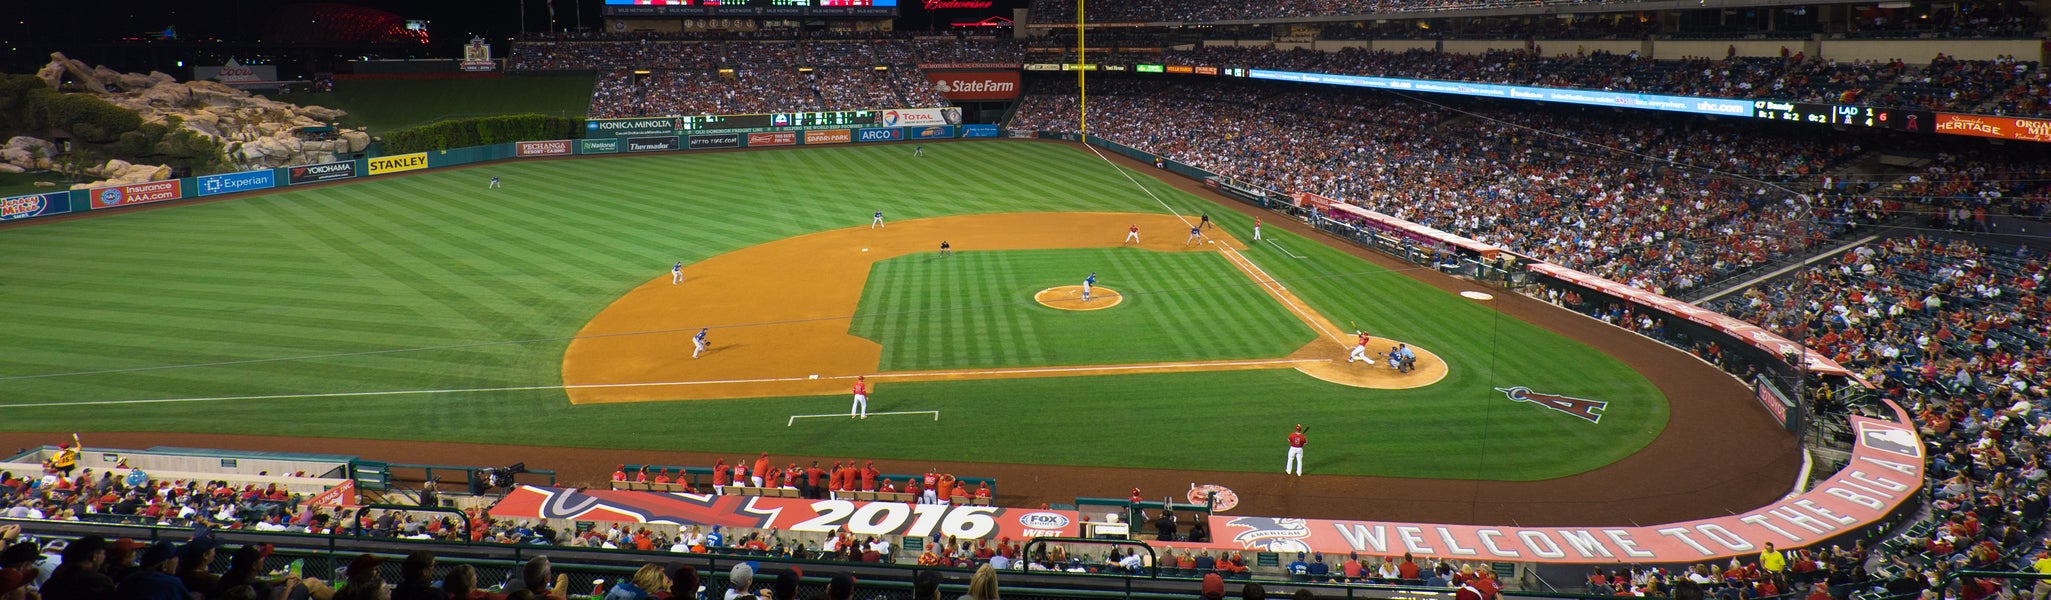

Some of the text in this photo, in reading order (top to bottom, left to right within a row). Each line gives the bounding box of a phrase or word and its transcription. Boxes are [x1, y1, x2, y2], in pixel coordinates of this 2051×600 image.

[922, 0, 993, 10] Budweiser
[1697, 102, 1744, 114] uhc.com
[1755, 101, 1766, 109] 47
[1839, 106, 1874, 117] LAD 1
[1879, 113, 1887, 121] 6
[600, 120, 671, 130] KONICA MINOLTA
[1865, 118, 1874, 127] 4
[2015, 119, 2051, 130] ORGA
[1936, 122, 2001, 136] HERITAGE
[862, 130, 890, 140] ARCO
[630, 142, 669, 150] Thermador
[306, 163, 351, 175] YOKOHAMA
[370, 156, 426, 171] STANLEY
[126, 182, 173, 194] Insurance
[224, 176, 268, 189] Experian
[1, 196, 39, 208] Jersey
[126, 191, 173, 204] AAA.com
[1333, 453, 1920, 560] WELCOME TO THE BIG A
[789, 500, 1001, 540] 2016
[1030, 515, 1059, 523] FOX
[1022, 528, 1064, 538] WEST
[1250, 529, 1301, 539] AMERICAN
